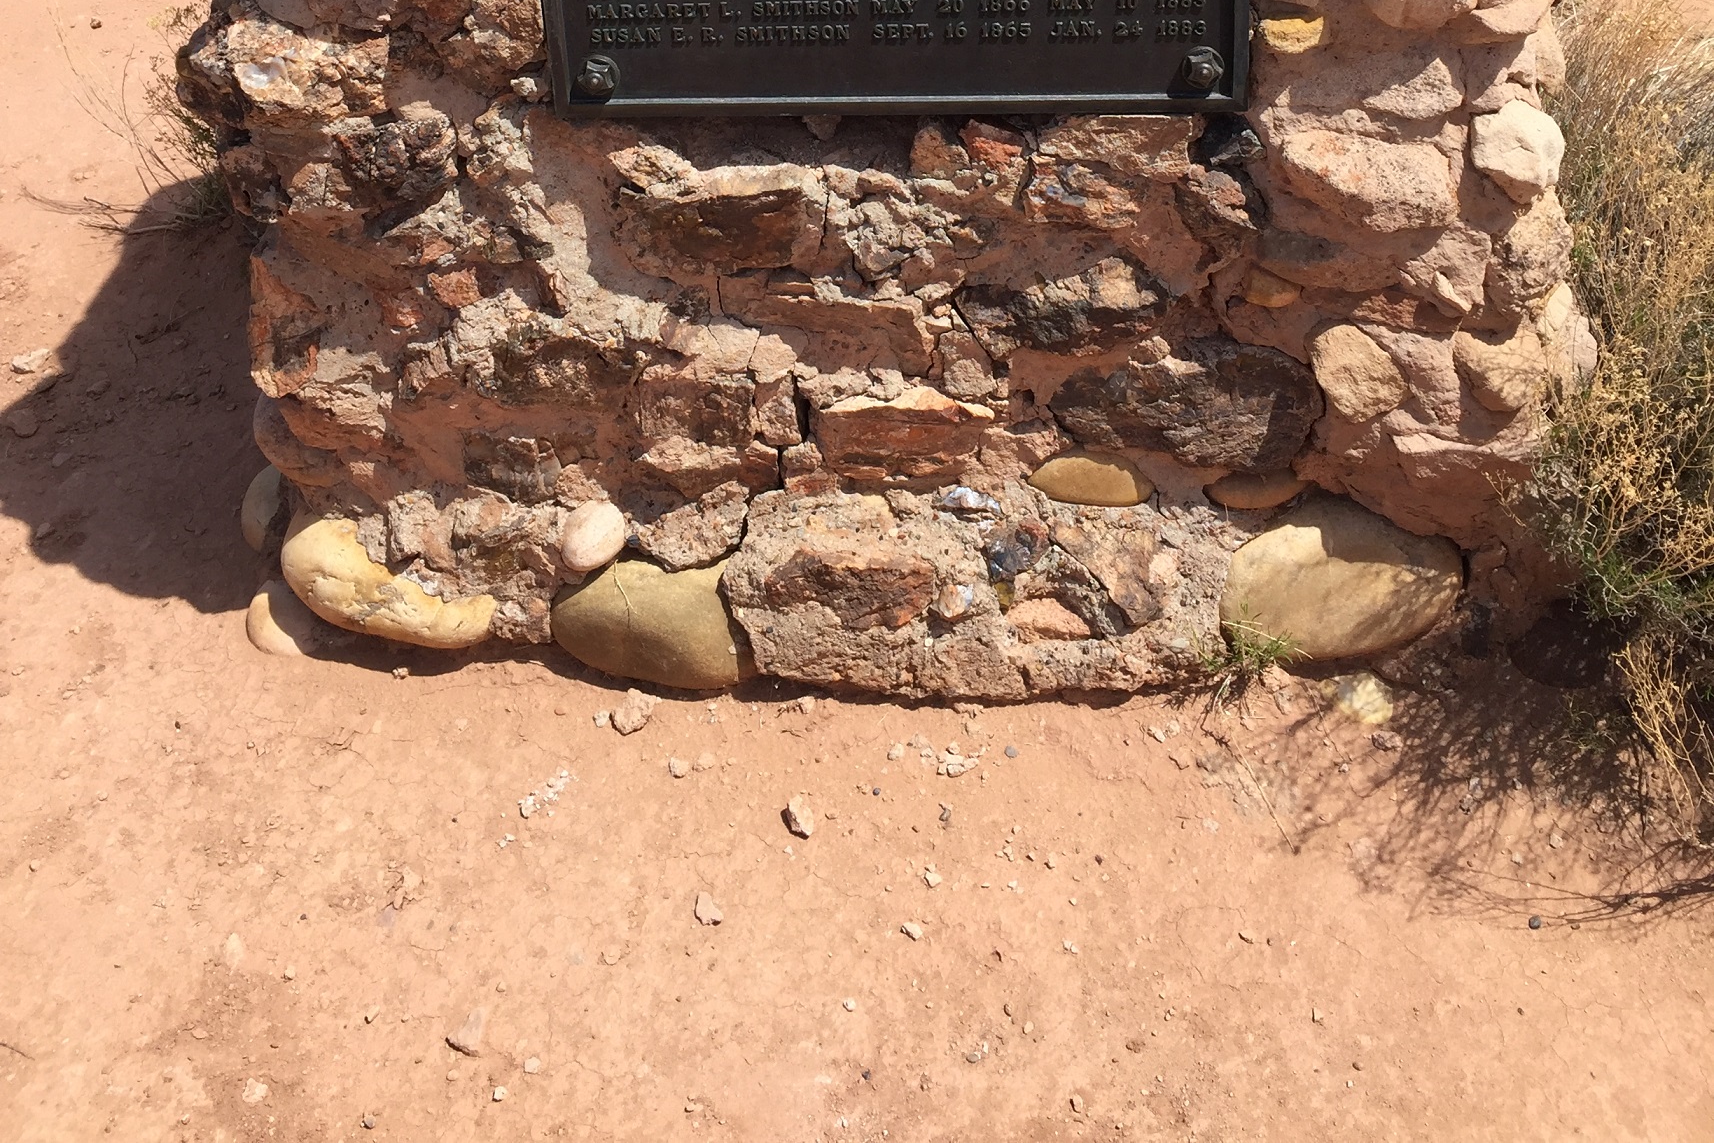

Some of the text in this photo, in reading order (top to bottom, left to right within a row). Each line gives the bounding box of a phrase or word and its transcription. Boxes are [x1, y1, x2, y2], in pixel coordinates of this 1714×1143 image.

[587, 3, 711, 20] MARGARET
[719, 2, 742, 17] L.
[752, 0, 859, 18] SMITHSON
[591, 18, 1207, 43] SUSAN E. R. SMITHSON SEPT. 16 1865 JAN. 24 1883
